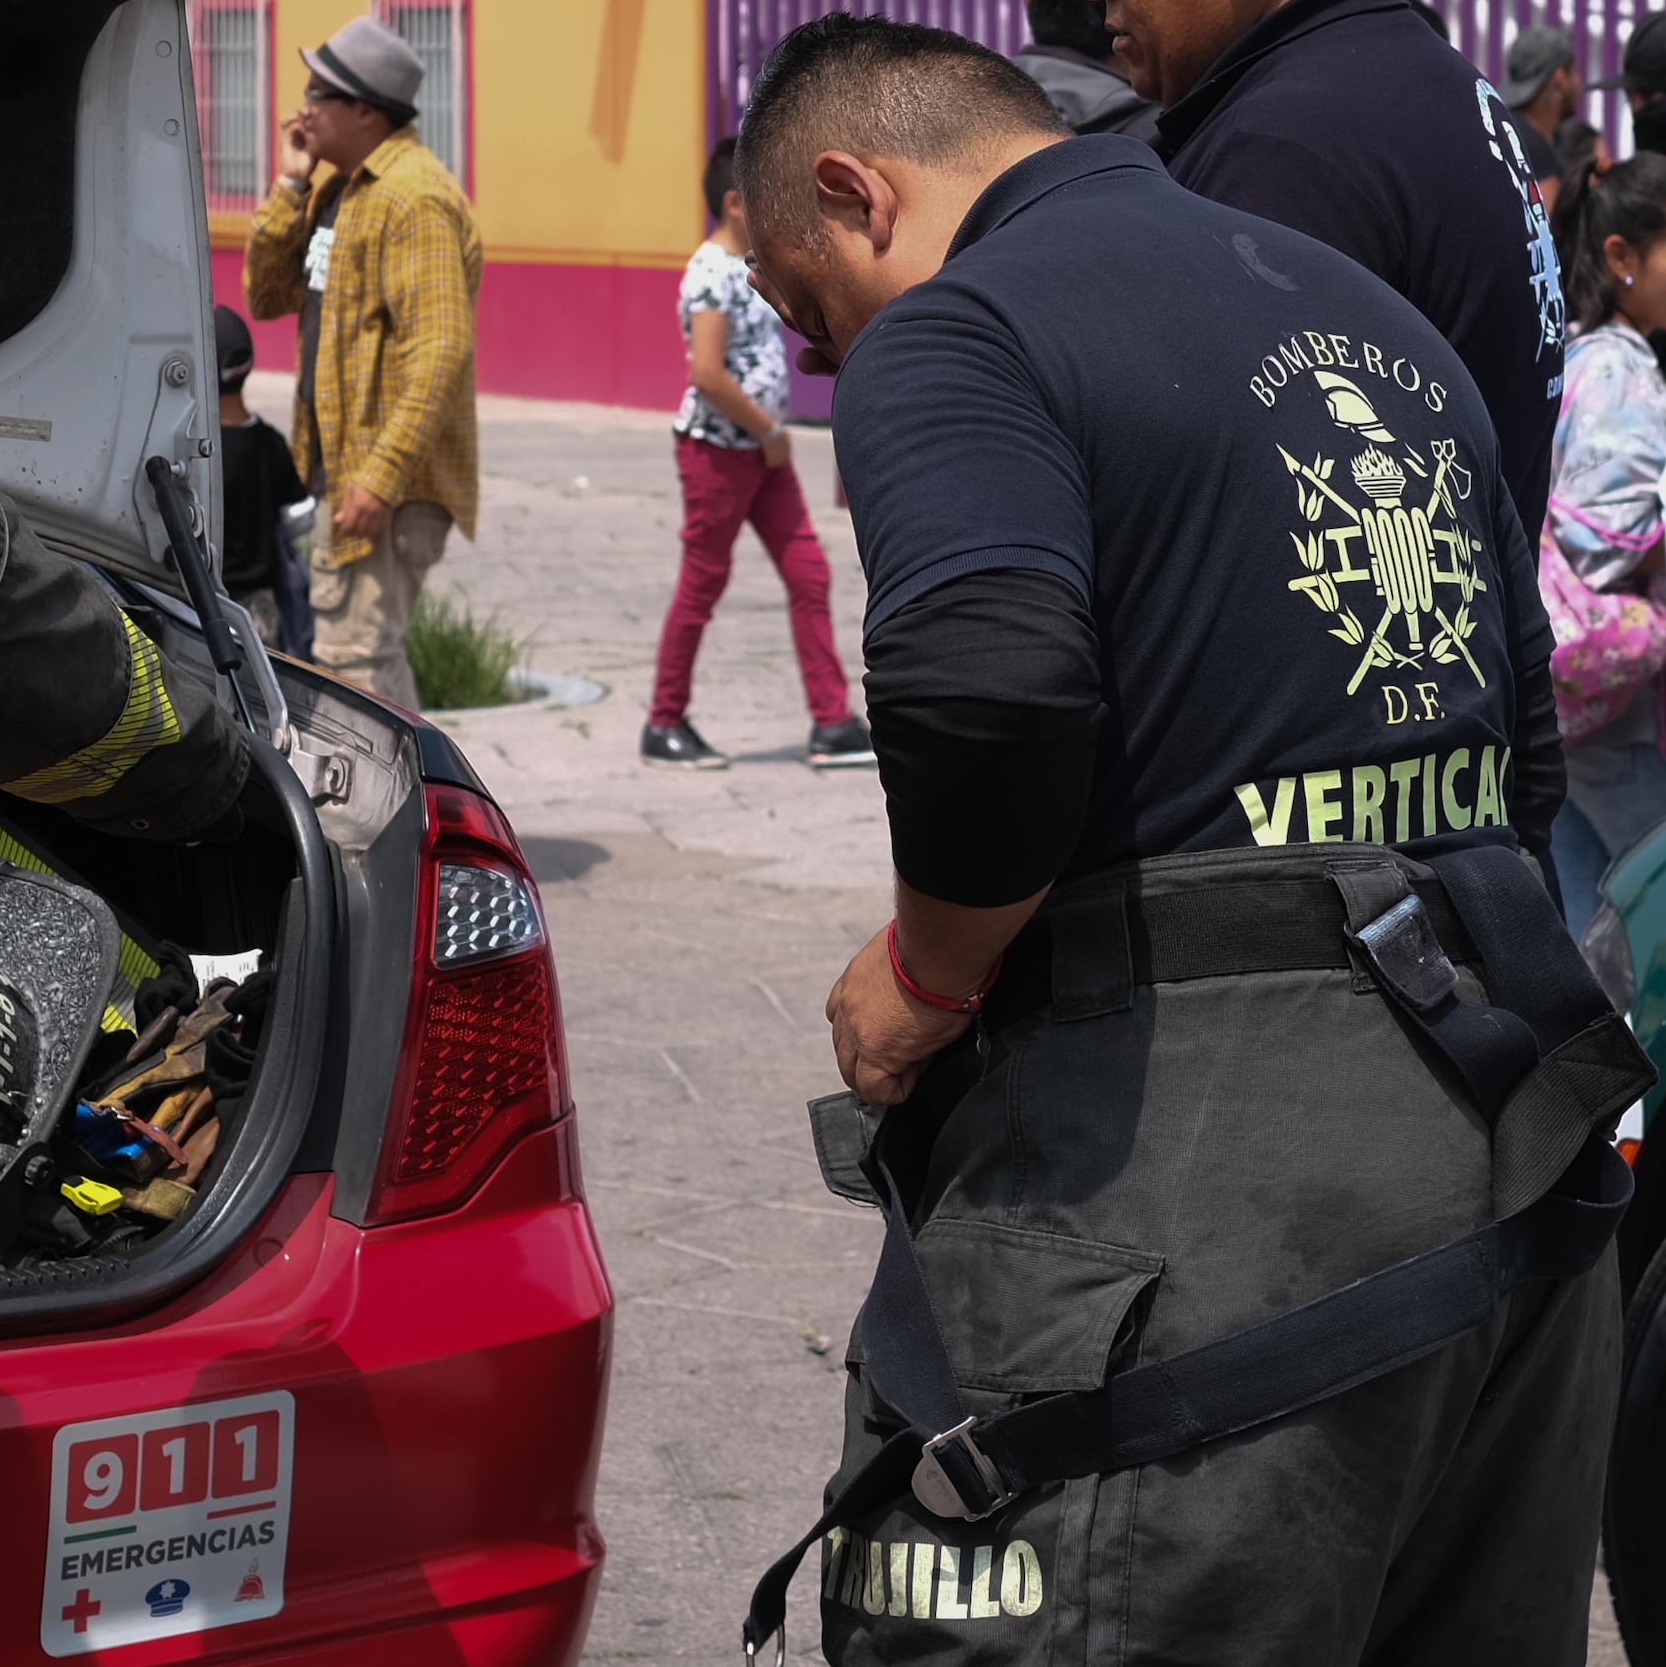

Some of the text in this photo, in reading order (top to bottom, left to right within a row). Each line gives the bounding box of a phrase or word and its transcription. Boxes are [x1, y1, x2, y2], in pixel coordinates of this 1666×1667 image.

[1249, 330, 1448, 413] BOMBEROS
[1382, 681, 1446, 725] D.F.
[1234, 745, 1510, 846] VERTICA
[82, 1424, 259, 1511] 911
[60, 1519, 276, 1581] EMERGENCIAS
